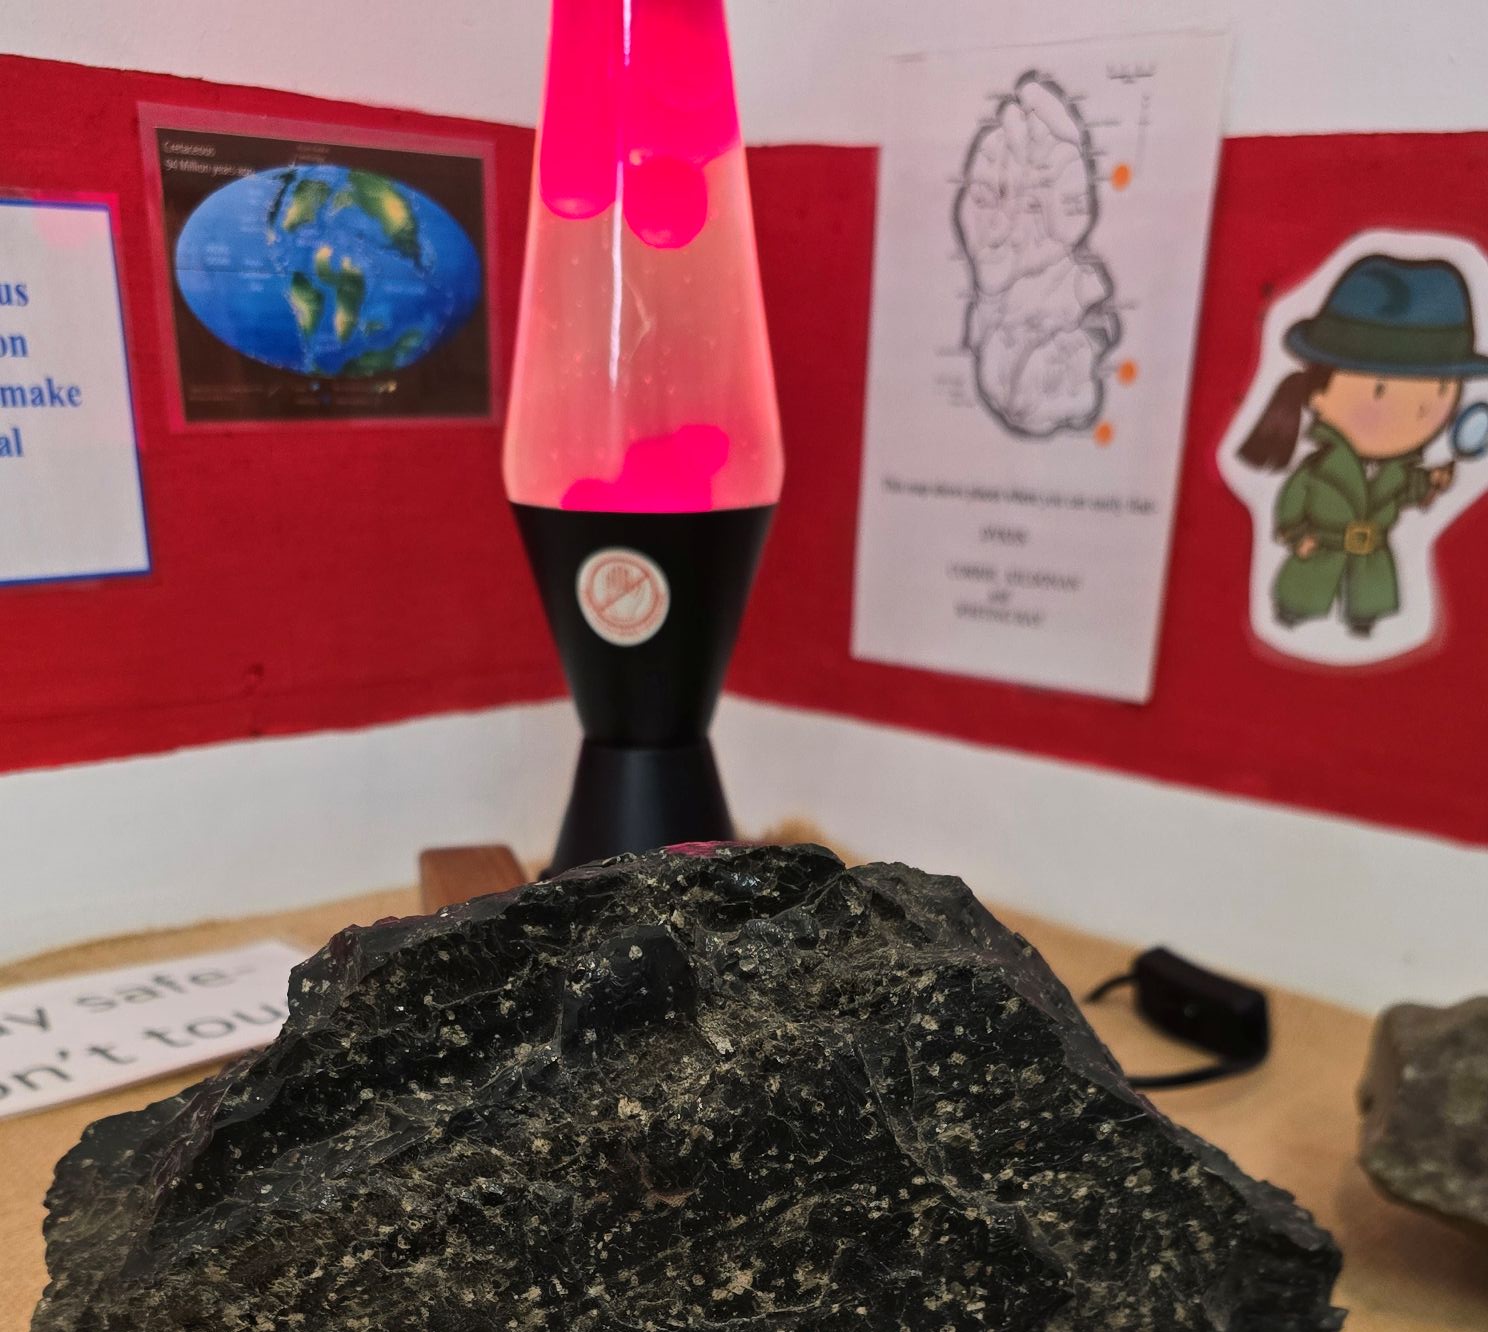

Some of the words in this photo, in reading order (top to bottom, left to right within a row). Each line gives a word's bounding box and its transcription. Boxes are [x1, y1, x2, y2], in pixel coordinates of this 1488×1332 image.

[0, 376, 81, 408] make
[0, 1046, 138, 1098] n't
[142, 1001, 288, 1048] tou
